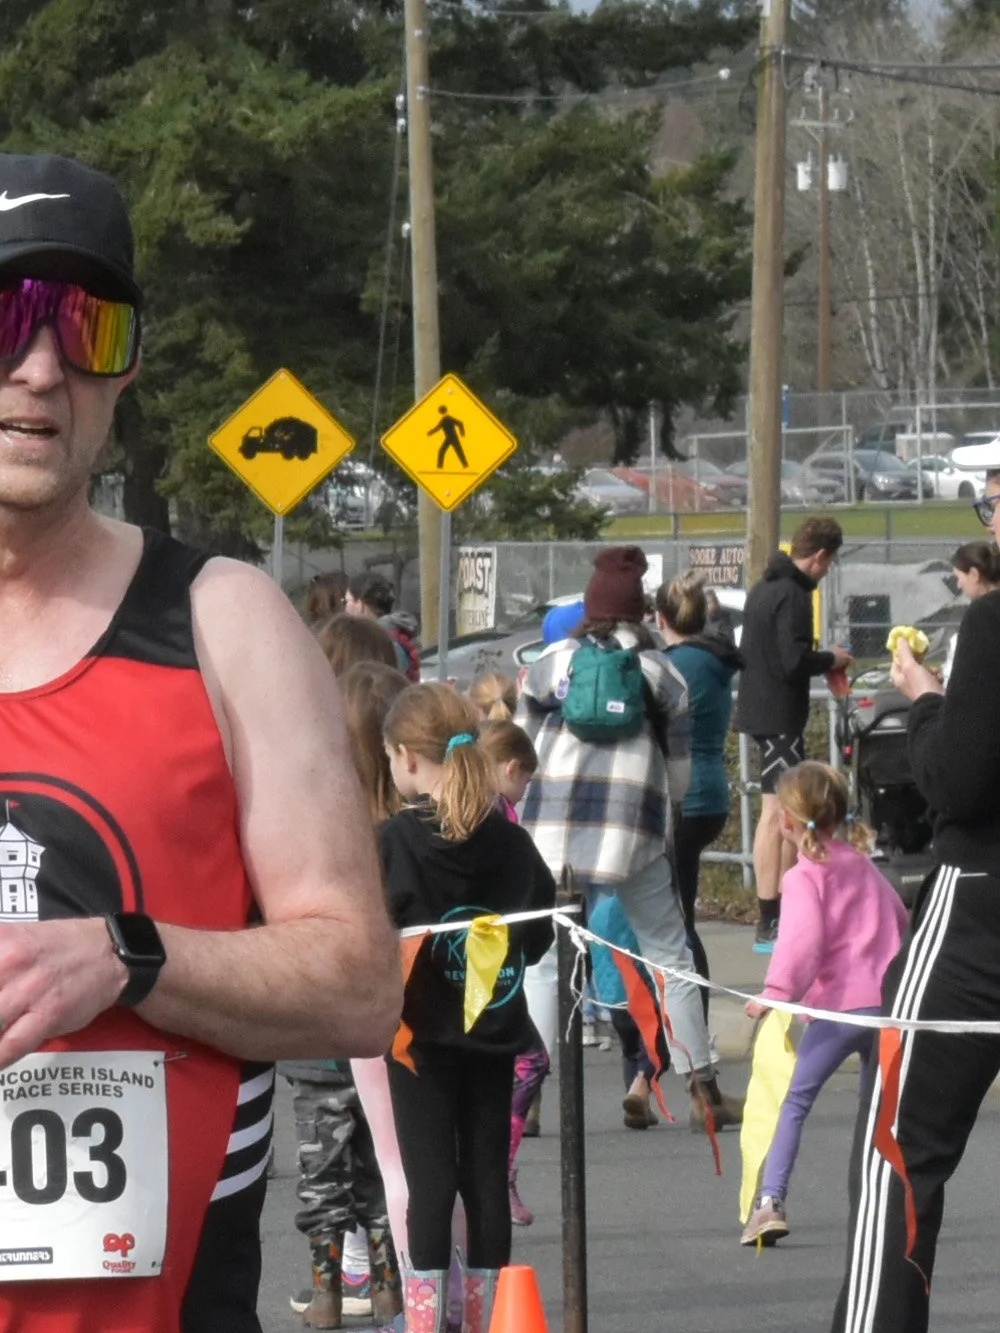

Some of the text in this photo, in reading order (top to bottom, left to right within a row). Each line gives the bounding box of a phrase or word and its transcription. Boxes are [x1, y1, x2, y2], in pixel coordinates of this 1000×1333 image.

[720, 547, 744, 565] AUTO
[91, 1067, 155, 1089] ISLAND
[3, 1082, 124, 1101] RACE SERIES
[102, 1259, 136, 1271] Quality
